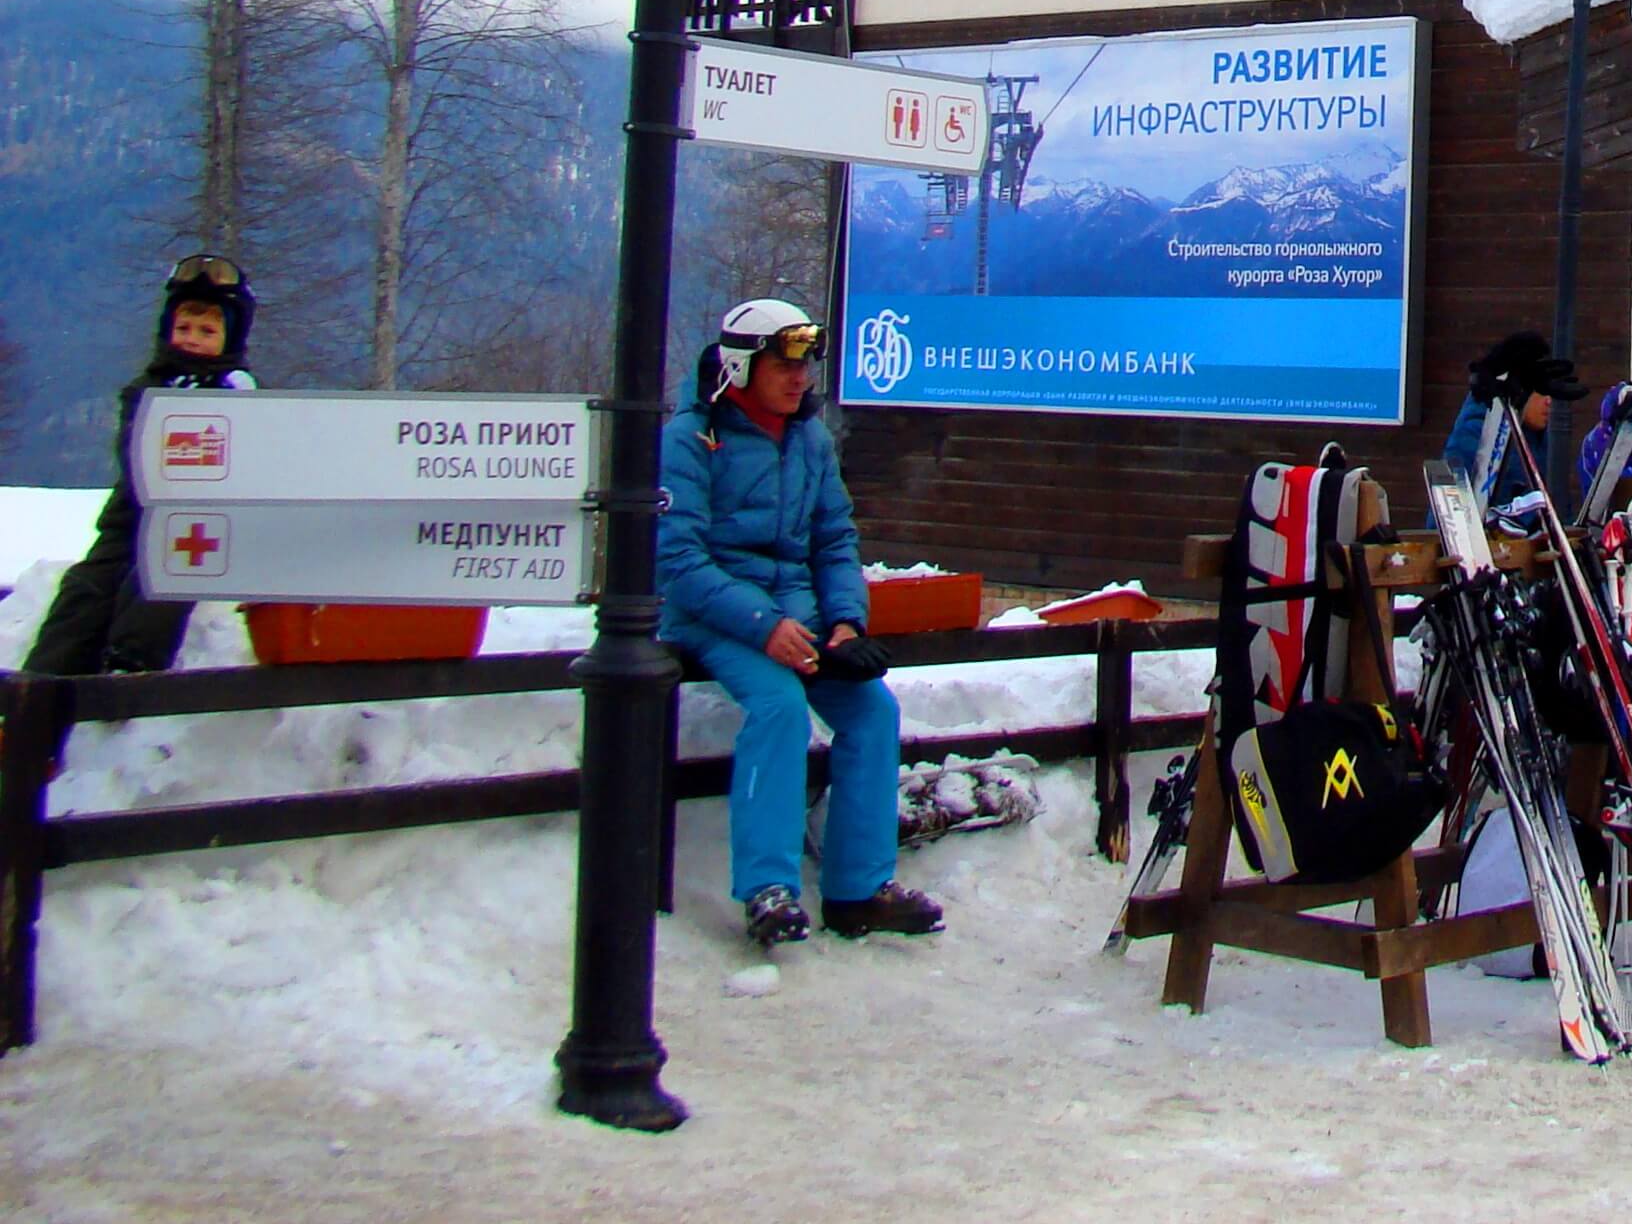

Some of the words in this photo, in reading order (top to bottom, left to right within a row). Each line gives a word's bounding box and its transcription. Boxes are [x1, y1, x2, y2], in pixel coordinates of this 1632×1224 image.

[1212, 43, 1388, 85] РАЗВИТИЕ
[704, 65, 777, 96] ТУАЛЕТ
[703, 99, 728, 121] WC
[959, 104, 972, 116] WC
[1092, 93, 1386, 138] ИНФРАСТРУКТУРЫ
[1168, 239, 1272, 261] Строительство
[1275, 242, 1383, 261] горнолыжного
[1228, 268, 1284, 287] курорта
[1288, 265, 1328, 283] «Роза
[1332, 265, 1383, 288] Хутор»
[923, 346, 1196, 376] ВНЕШЭКОНОМБАНК
[397, 421, 468, 447] РОЗА
[478, 421, 577, 447] ПРИЮТ
[417, 456, 477, 479] ROSA
[486, 457, 576, 479] LOUNGE
[417, 521, 566, 551] МЕДПУНКТ
[453, 557, 519, 579] FIRST
[523, 558, 566, 580] AID
